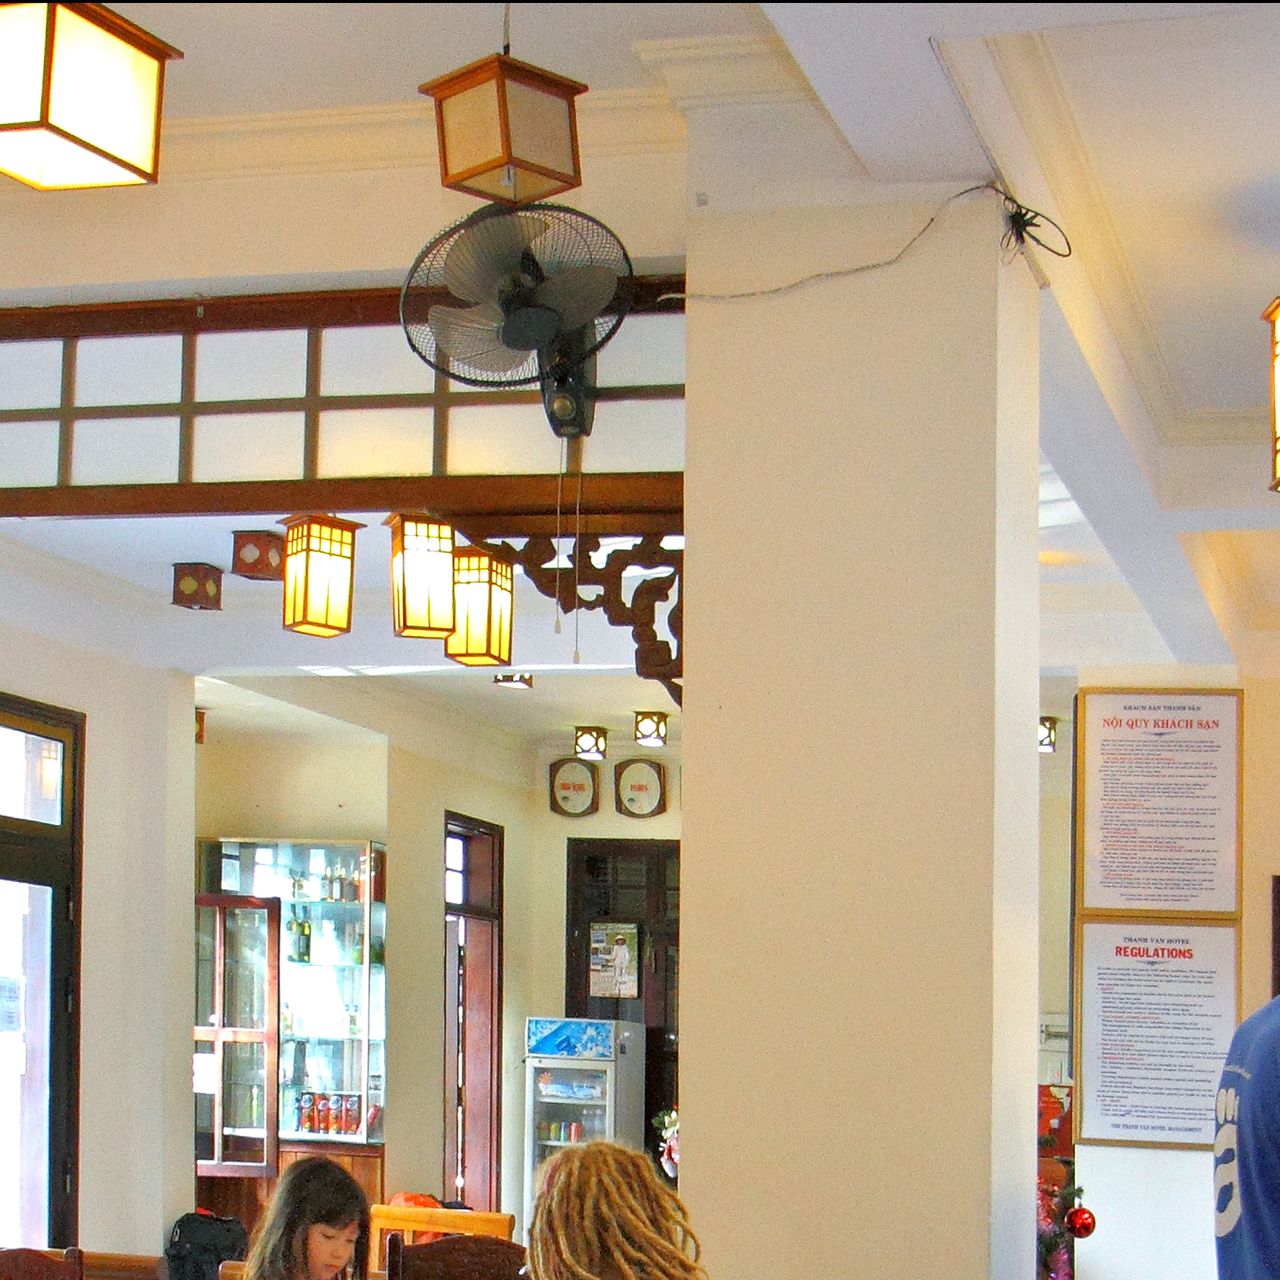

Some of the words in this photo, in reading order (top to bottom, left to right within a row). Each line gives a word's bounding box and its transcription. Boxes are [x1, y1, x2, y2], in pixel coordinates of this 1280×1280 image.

[1102, 717, 1122, 729] NỘI
[1126, 719, 1150, 729] QUY
[1153, 717, 1193, 729] KHÁCH
[1196, 719, 1220, 730] SẠN
[1115, 946, 1194, 959] REGULATIONS
